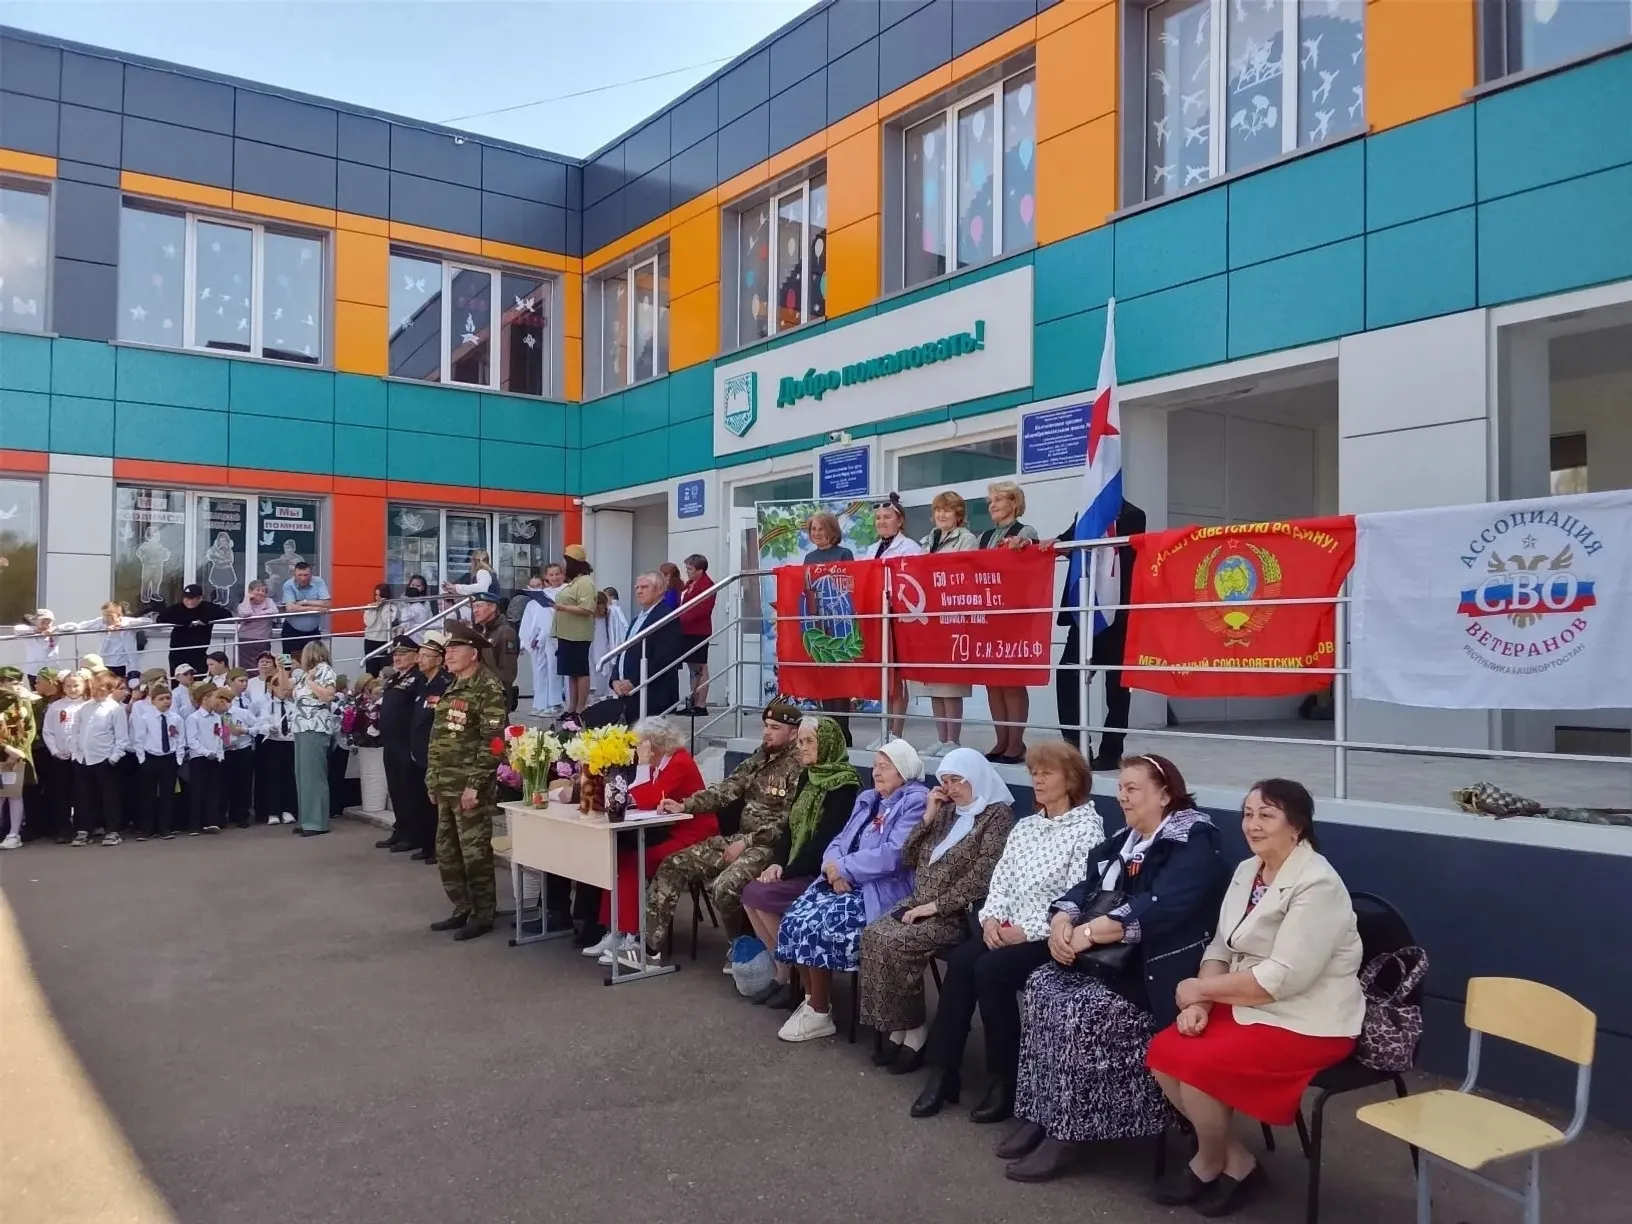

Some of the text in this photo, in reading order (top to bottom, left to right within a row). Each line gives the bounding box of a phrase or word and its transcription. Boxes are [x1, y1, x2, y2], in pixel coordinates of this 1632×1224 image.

[777, 319, 986, 409] Добро пожаловать!
[265, 522, 312, 530] помним
[279, 508, 300, 517] Мы
[1272, 522, 1339, 554] РОДИНУ!
[1460, 510, 1604, 570] АССОЦИАЦИЯ
[933, 571, 946, 587] 150
[1475, 572, 1579, 612] СВО
[951, 634, 970, 662] 79
[1465, 617, 1588, 658] ВЕТЕРАНОВ
[1242, 656, 1304, 669] СОВЕТСКИХ
